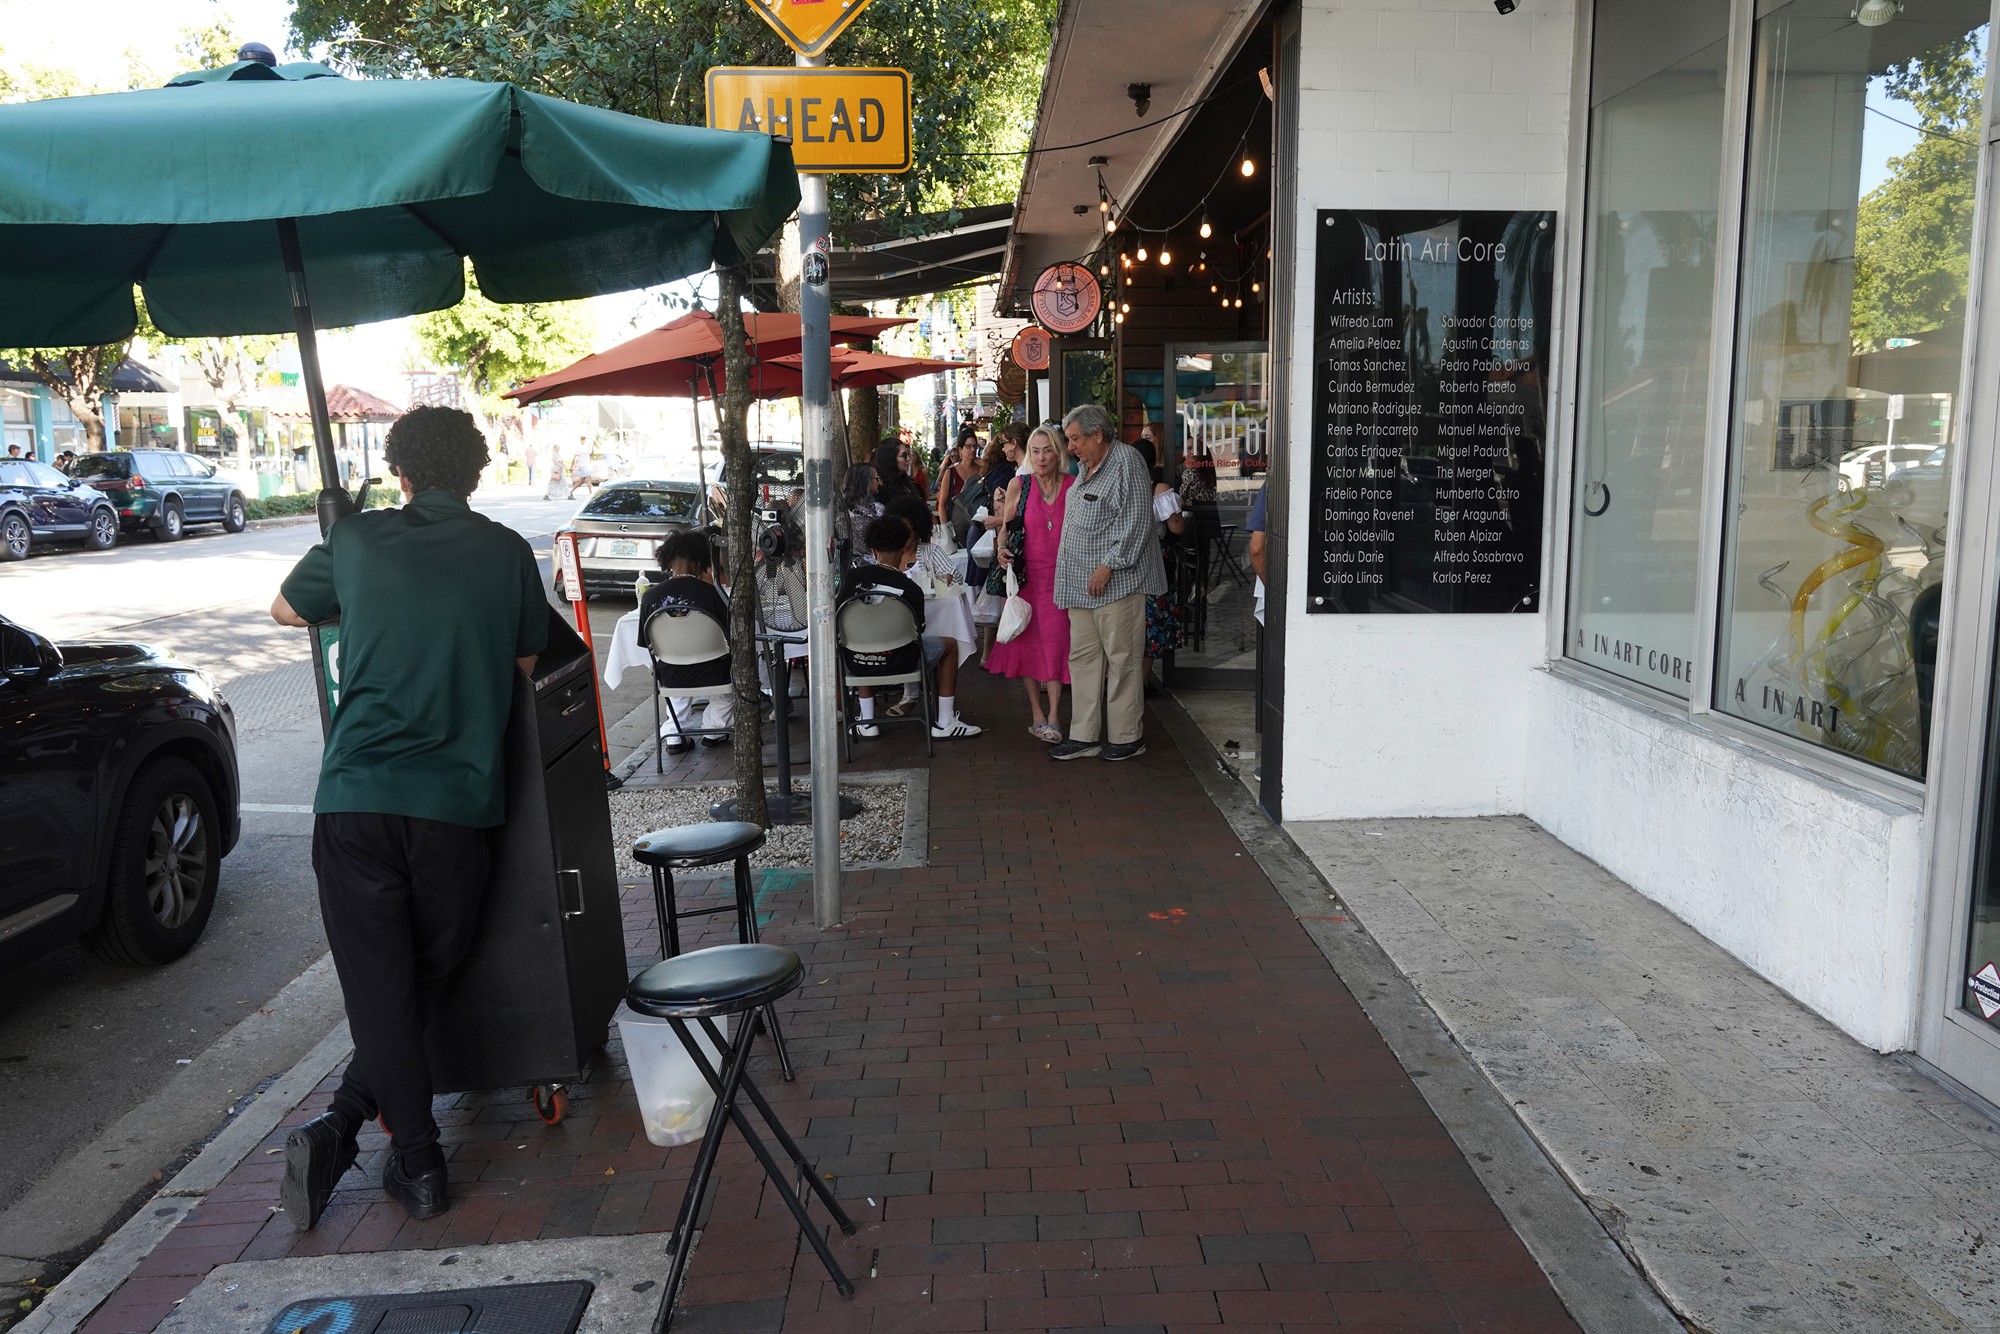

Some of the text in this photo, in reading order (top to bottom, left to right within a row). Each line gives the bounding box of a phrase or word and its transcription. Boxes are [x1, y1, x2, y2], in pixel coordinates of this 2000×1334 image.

[737, 97, 885, 143] AHEAD
[1363, 236, 1507, 262] Latin Art Core
[1331, 288, 1376, 306] Artists:
[1330, 315, 1394, 329] Wifredo Lam
[1441, 315, 1534, 331] Salvador Corratge
[1329, 337, 1401, 351] Amelia Pelaez
[1440, 337, 1530, 353] Agustin Cardenas
[1328, 358, 1406, 372] Tomas Sanchez
[1440, 358, 1531, 372] Pedro Pablo Oliva
[1327, 380, 1416, 393] Cundo Bermudez
[1439, 380, 1517, 393] Roberto Fabelo
[1327, 402, 1423, 418] Mariano Rodriguez
[1438, 402, 1525, 418] Ramon Alejandro
[1327, 423, 1419, 436] Rene Portocarrero
[1437, 423, 1521, 436] Manuel Mendive
[1326, 444, 1403, 460] Carlos Enriquez
[1436, 444, 1509, 460] Miguel Padura
[1216, 458, 1242, 468] Rican
[1326, 465, 1396, 479] Victor Manuel
[1436, 465, 1493, 481] The Merger
[1325, 487, 1393, 500] Fidelio Ponce
[1435, 487, 1520, 500] Humberto Castro
[1324, 508, 1415, 524] Domingo Ravenet
[1435, 508, 1508, 524] Elger Aragundi
[1324, 529, 1395, 543] Lolo Soldevilla
[1434, 529, 1503, 544] Ruben Alpizar
[1323, 550, 1385, 564] Sandu Darie
[1433, 550, 1524, 564] Alfredo Sosabravo
[1322, 571, 1384, 584] Guido Llinas
[1432, 571, 1492, 584] Karlos Perez
[1613, 639, 1643, 666] ART
[1648, 649, 1692, 683] CORE
[1793, 695, 1840, 733] ART
